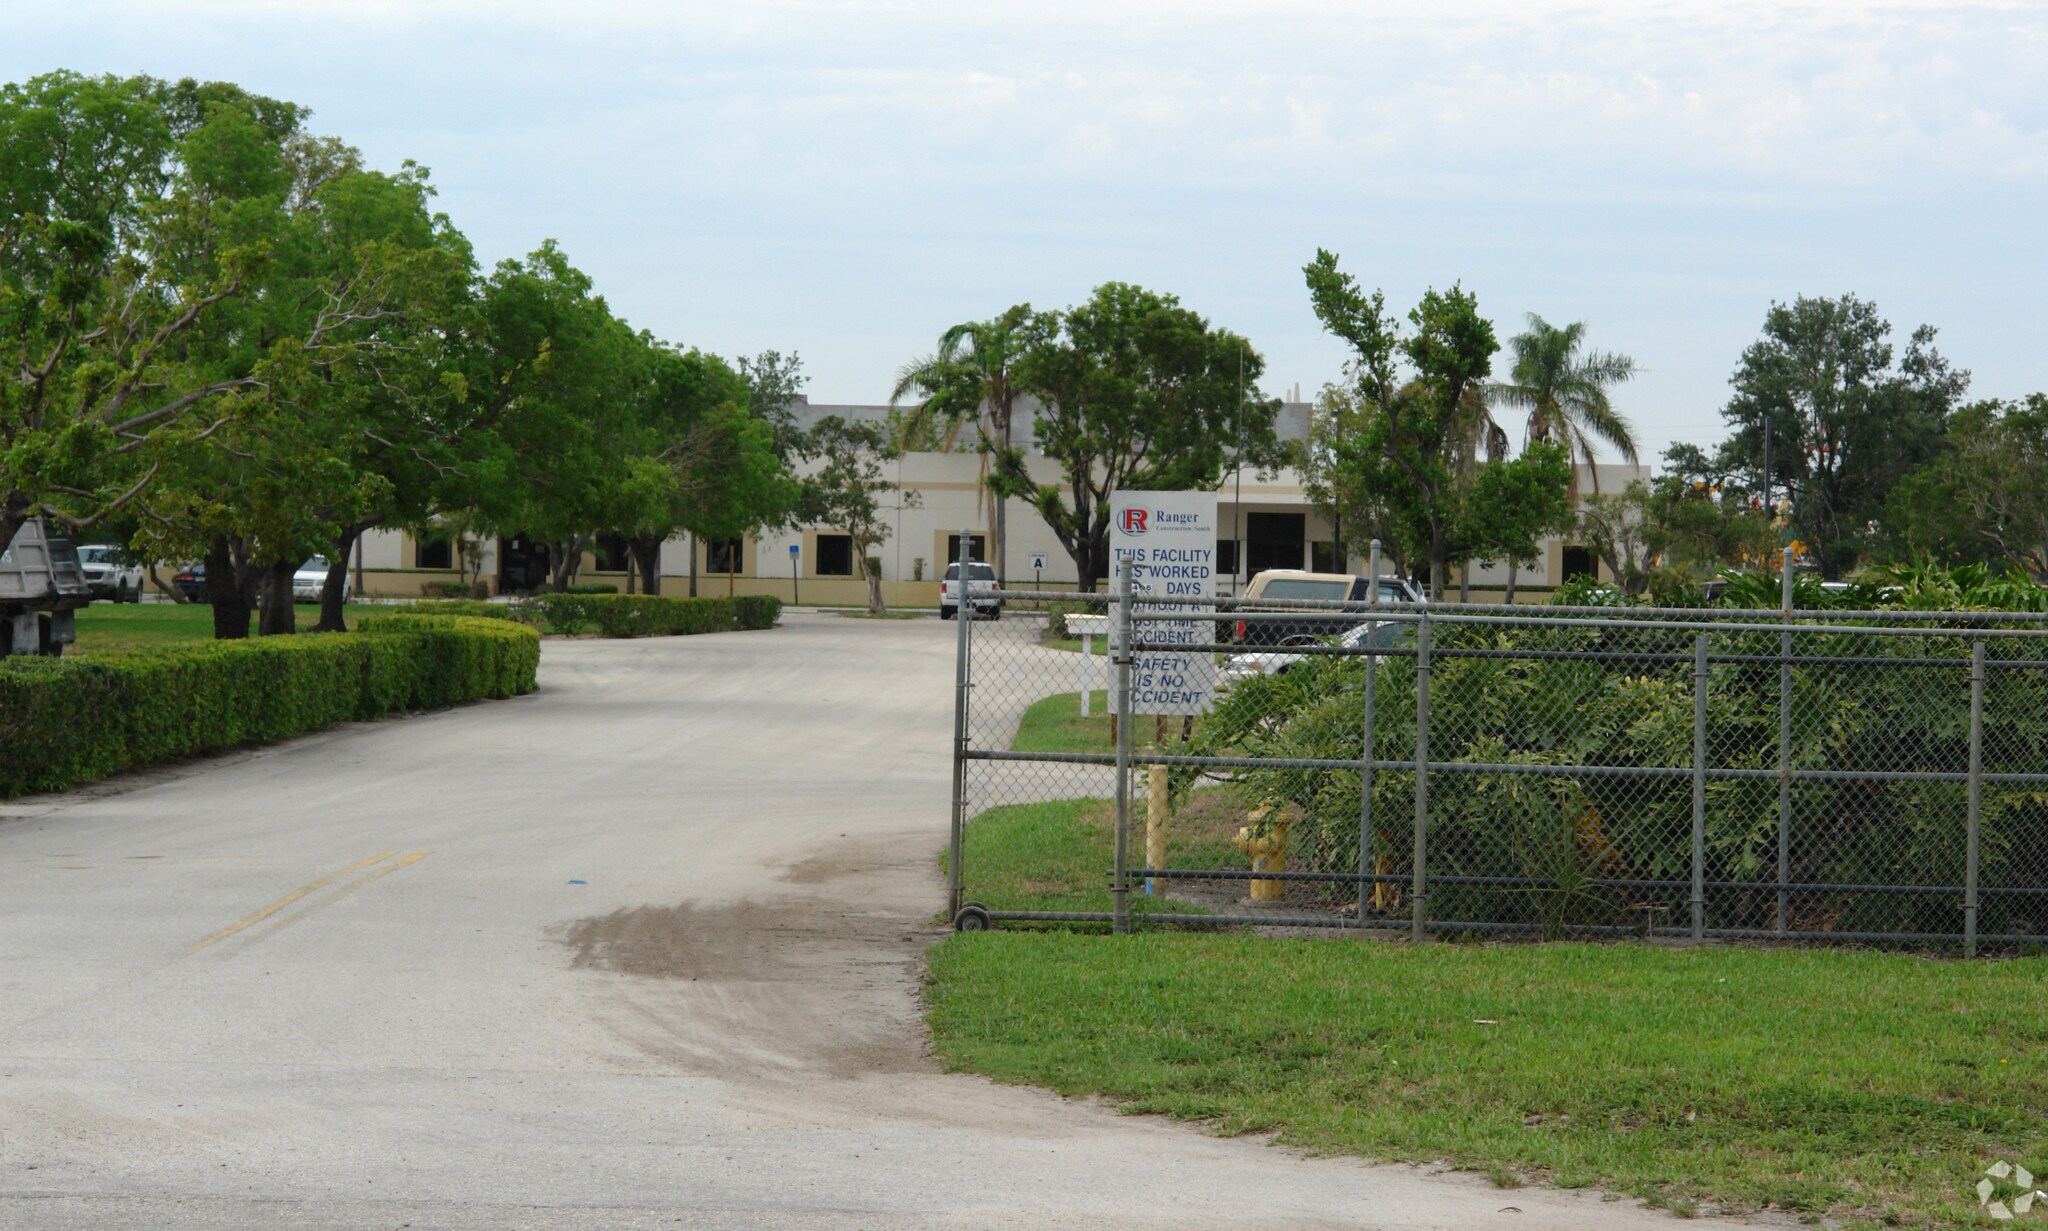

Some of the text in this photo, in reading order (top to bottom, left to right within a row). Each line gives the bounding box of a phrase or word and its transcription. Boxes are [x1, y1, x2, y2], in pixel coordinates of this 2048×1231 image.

[1156, 510, 1199, 525] Ranger
[1115, 548, 1211, 562] THIS FACILITY
[1034, 558, 1043, 568] A
[1115, 565, 1210, 578] HS WORKED
[1167, 582, 1201, 595] DAYS
[1131, 658, 1191, 671] SAFETY
[1137, 674, 1184, 688] IS NO
[1130, 690, 1203, 704] CCIDENT
